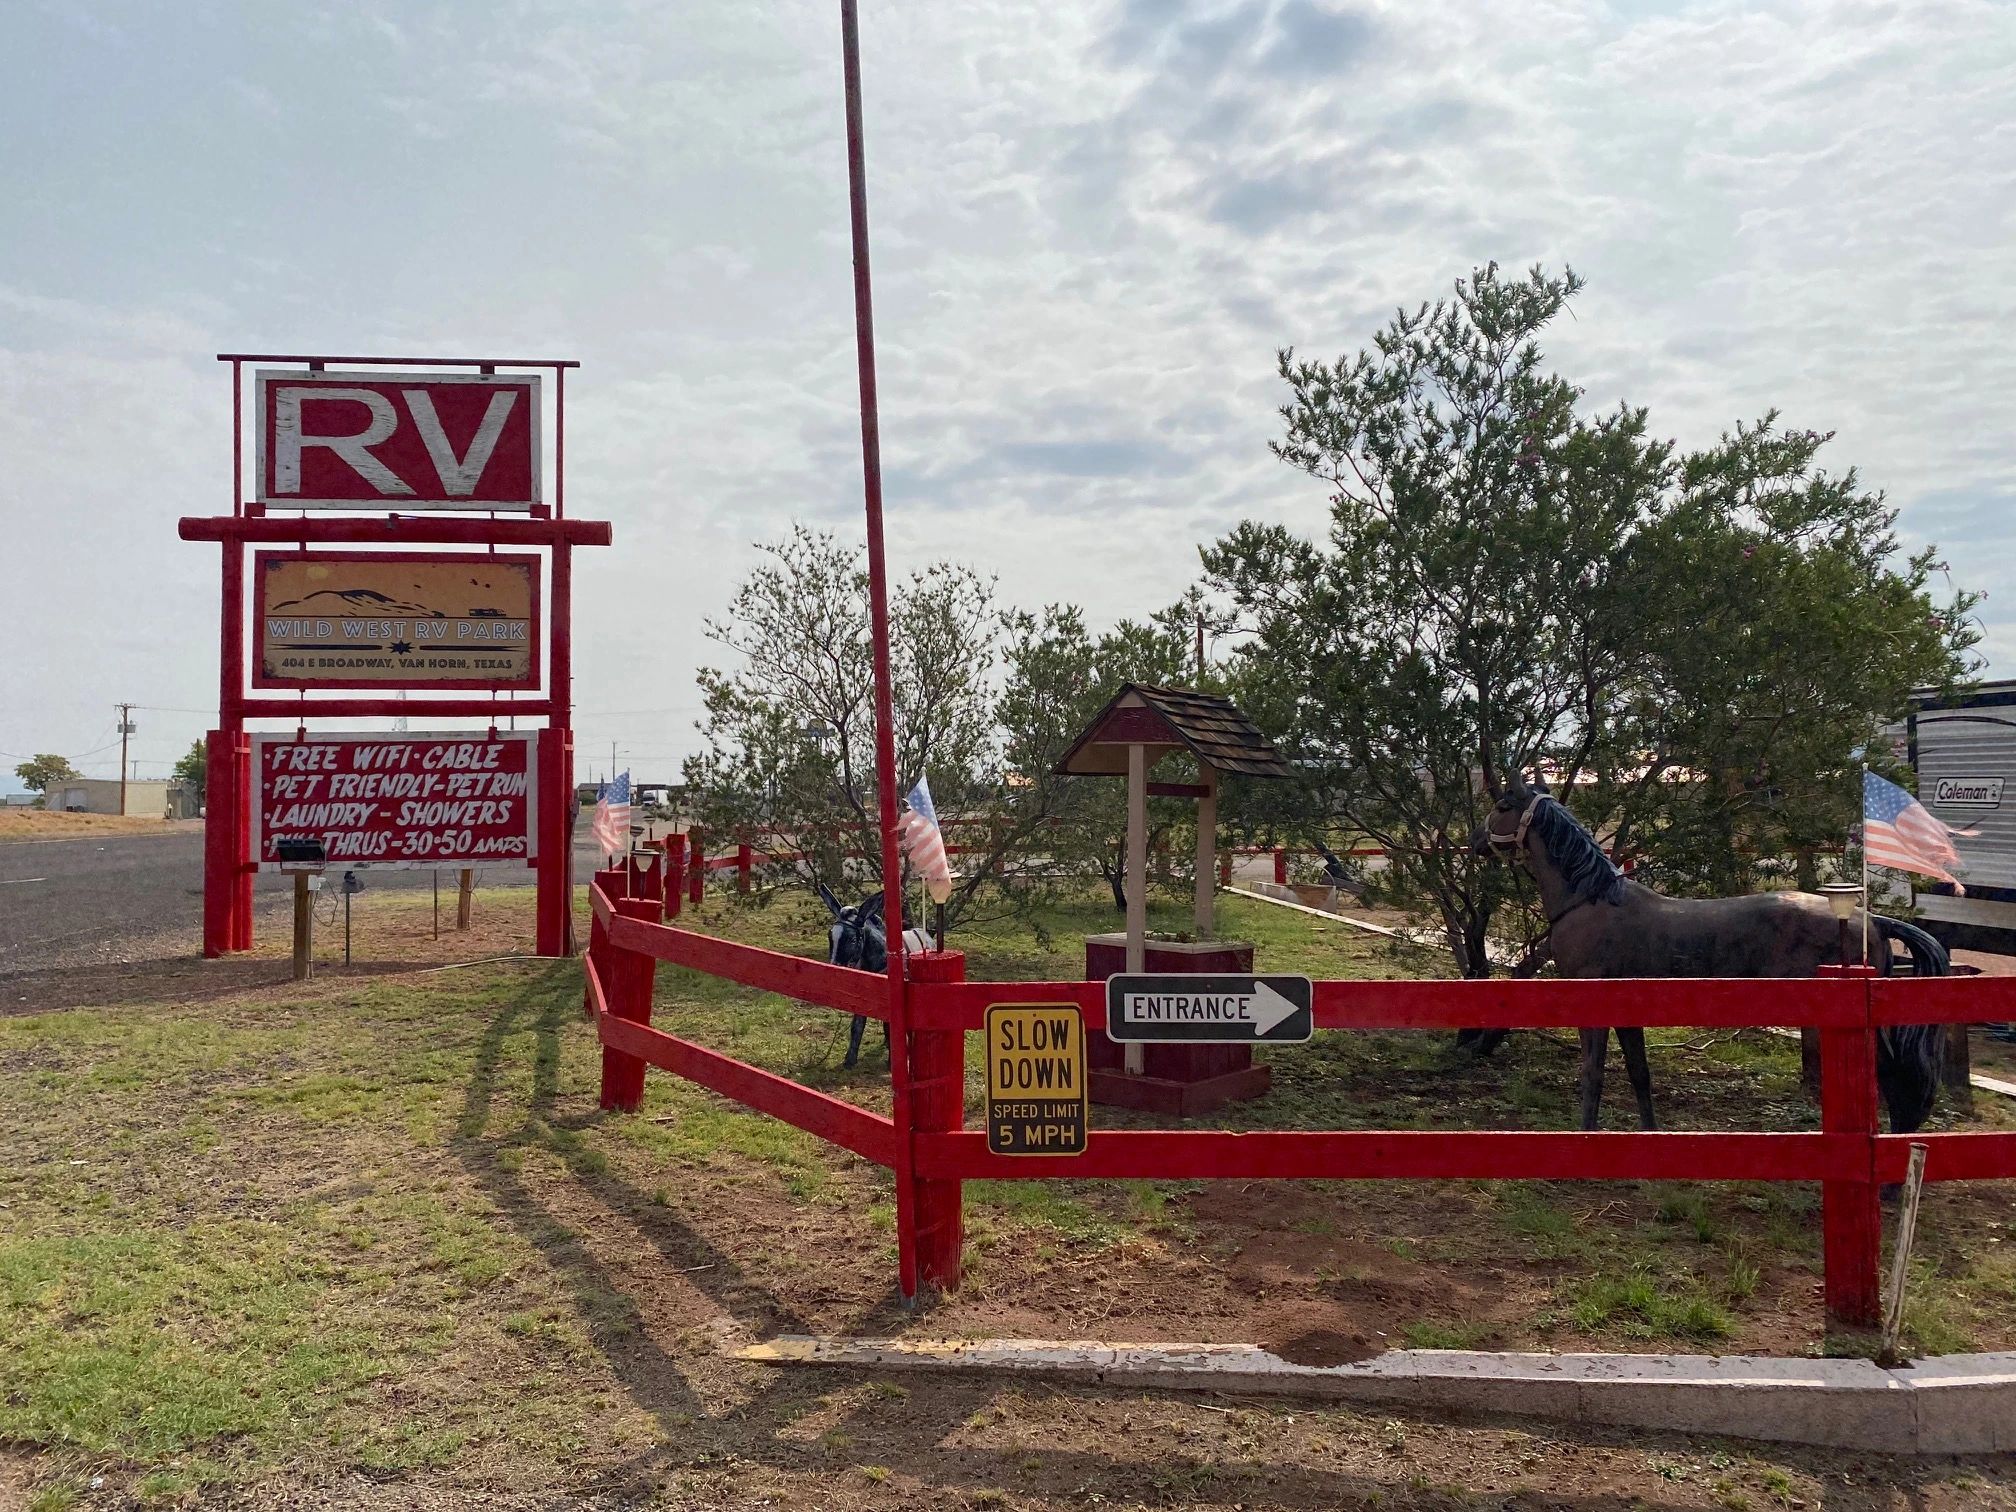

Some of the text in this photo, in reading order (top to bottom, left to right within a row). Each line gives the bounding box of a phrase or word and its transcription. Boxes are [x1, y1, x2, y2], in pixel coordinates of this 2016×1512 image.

[275, 387, 518, 495] RV
[268, 620, 526, 640] WILD WEST RV PARK
[282, 658, 512, 670] 404 E BROADWAY, VAN HORN, TEXAS
[271, 745, 342, 771] FREE
[422, 744, 504, 769] CABLE
[272, 774, 324, 799] PET
[487, 772, 527, 797] RUN
[1939, 781, 1988, 799] Coleman
[269, 802, 379, 828] LAUNDRY
[396, 800, 513, 826] SHOWERS
[471, 836, 527, 853] AMPS
[1133, 997, 1251, 1019] ENTRANCE
[1001, 1019, 1069, 1051] SLOW
[1000, 1058, 1073, 1089] DOWN
[994, 1103, 1080, 1118] SPEED LIMIT
[1000, 1125, 1076, 1146] 5 MPH
